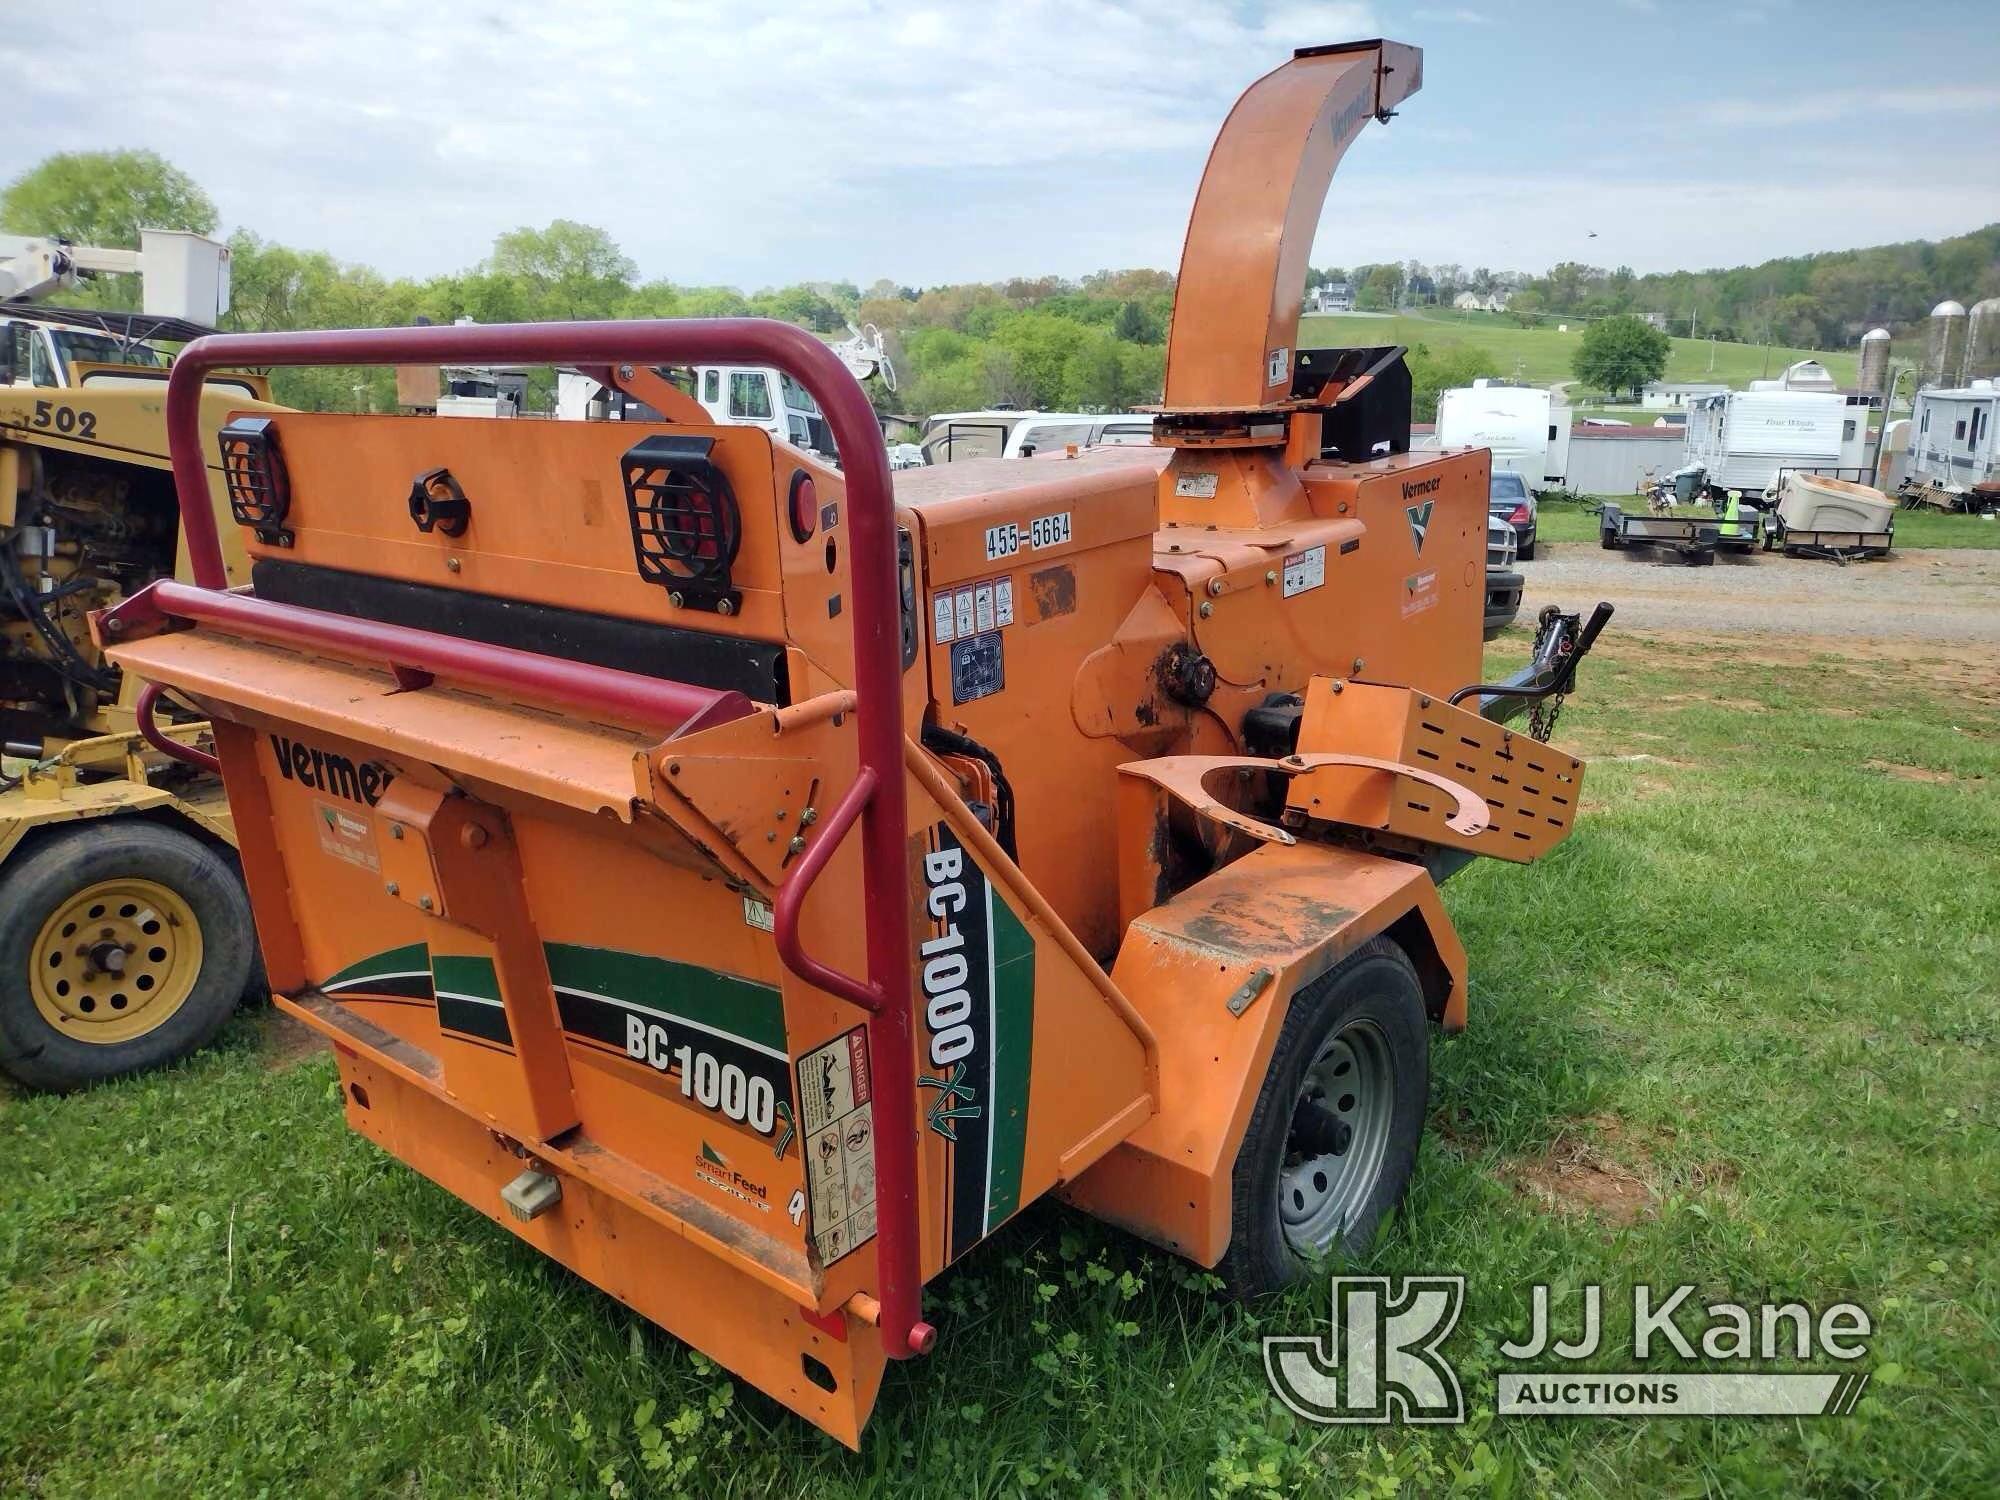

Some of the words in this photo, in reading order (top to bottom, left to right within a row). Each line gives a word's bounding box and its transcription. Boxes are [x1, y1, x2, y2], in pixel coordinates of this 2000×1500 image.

[33, 400, 97, 439] 502
[1402, 477, 1441, 500] Vermeer
[987, 514, 1070, 558] 455-5664
[853, 1048, 867, 1101] DANGER
